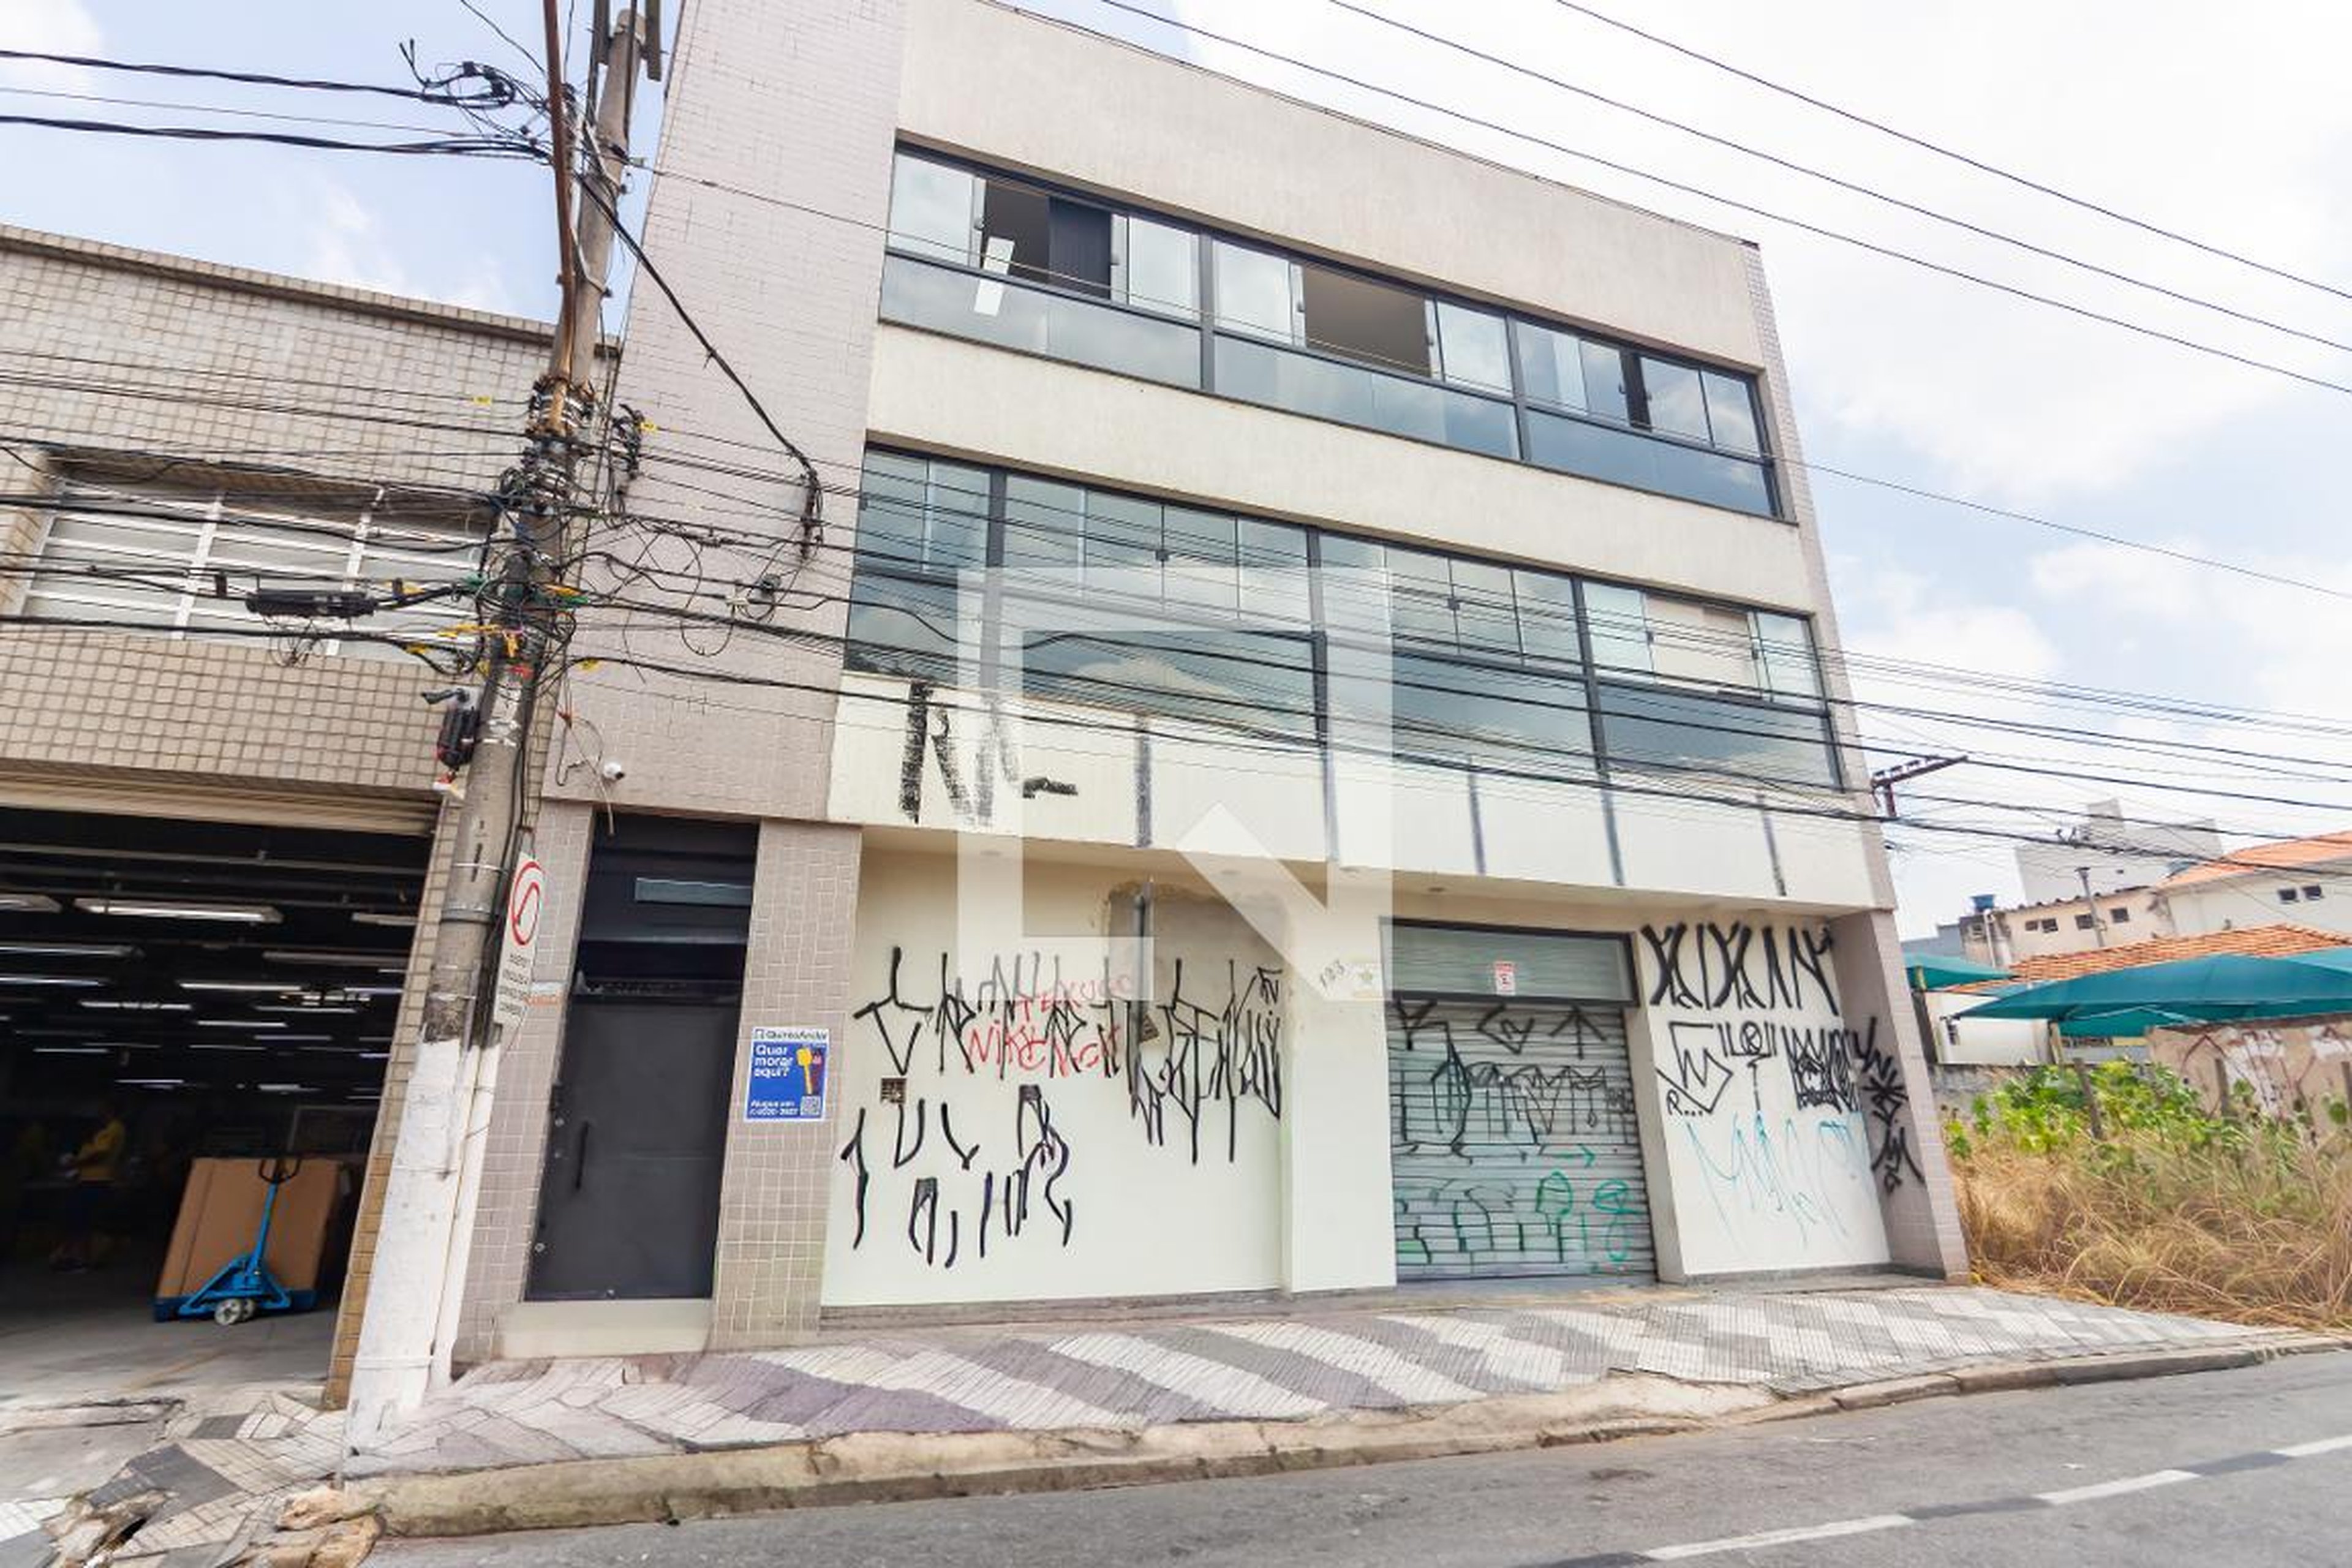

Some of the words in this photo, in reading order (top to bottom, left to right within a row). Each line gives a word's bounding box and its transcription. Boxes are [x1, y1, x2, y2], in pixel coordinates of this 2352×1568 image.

[756, 1044, 788, 1057] Quer
[755, 1057, 794, 1066] morar
[754, 1067, 790, 1079] aqui?
